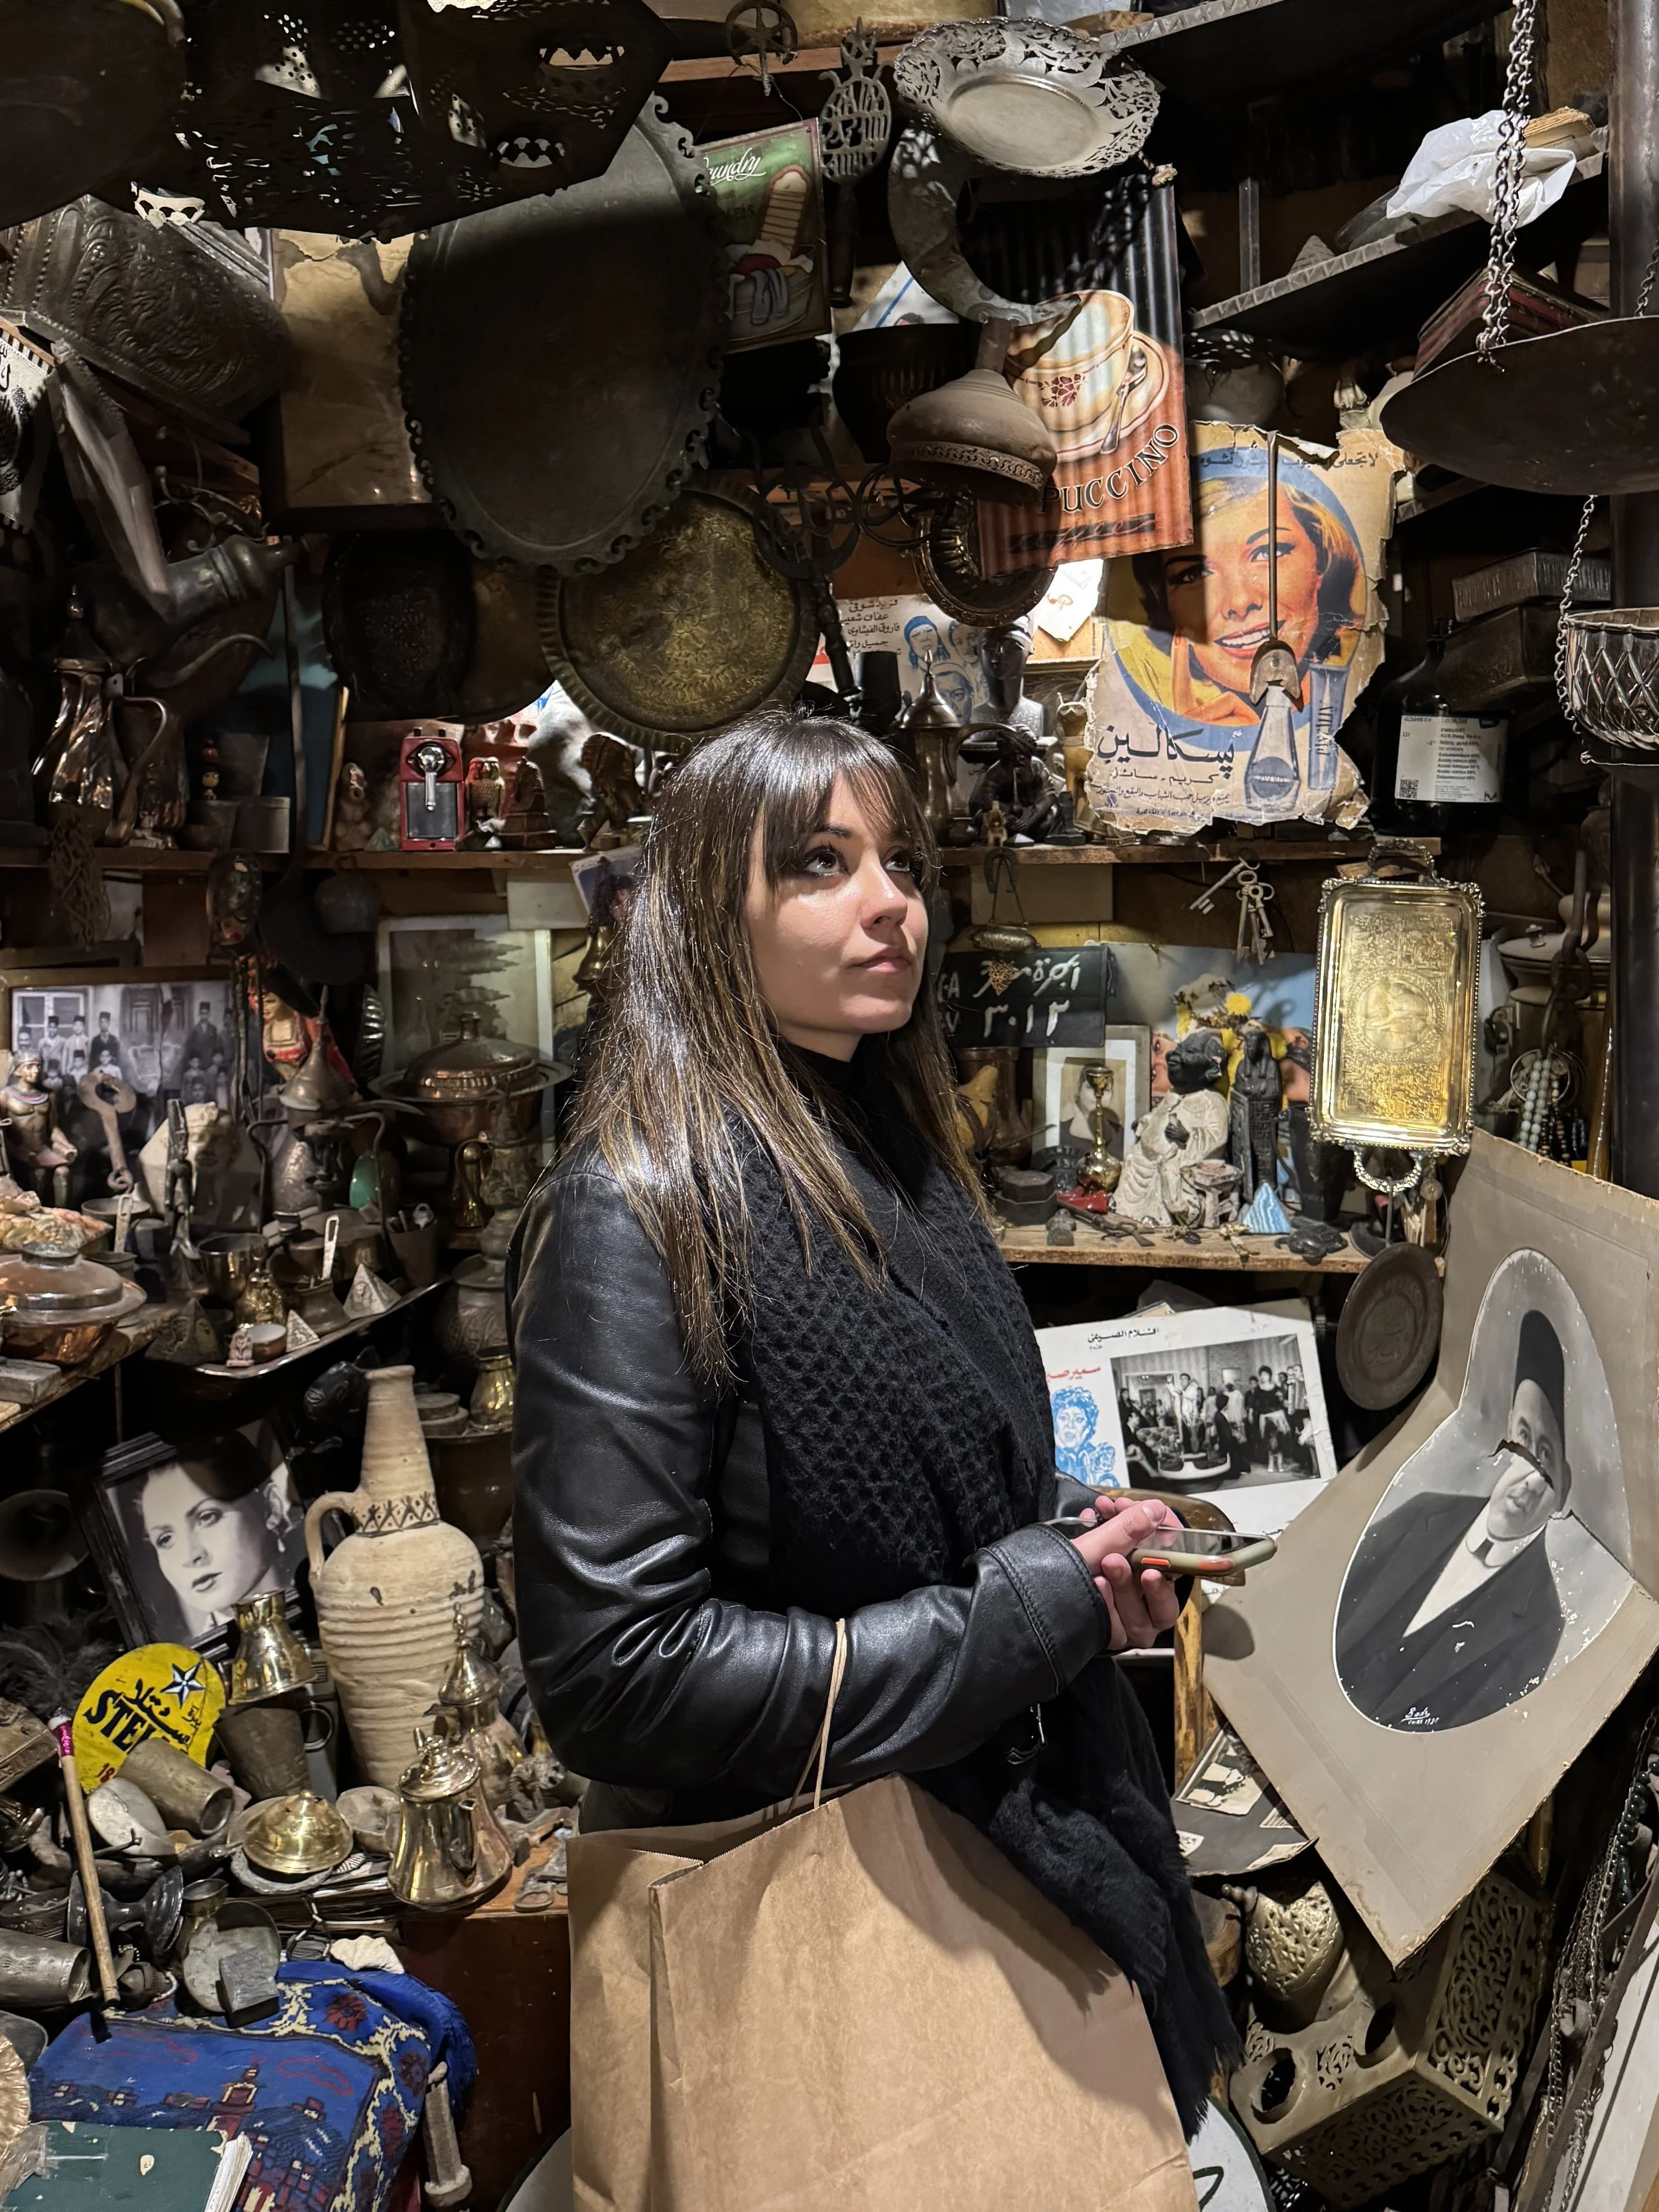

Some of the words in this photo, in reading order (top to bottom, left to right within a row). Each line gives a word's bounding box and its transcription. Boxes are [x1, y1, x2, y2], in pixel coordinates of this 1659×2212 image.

[1039, 424, 1179, 514] PUCCINO
[878, 622, 900, 634] فاروق
[1169, 773, 1220, 786] كريم
[83, 1689, 171, 1754] STEL
[97, 1762, 116, 1784] 18
